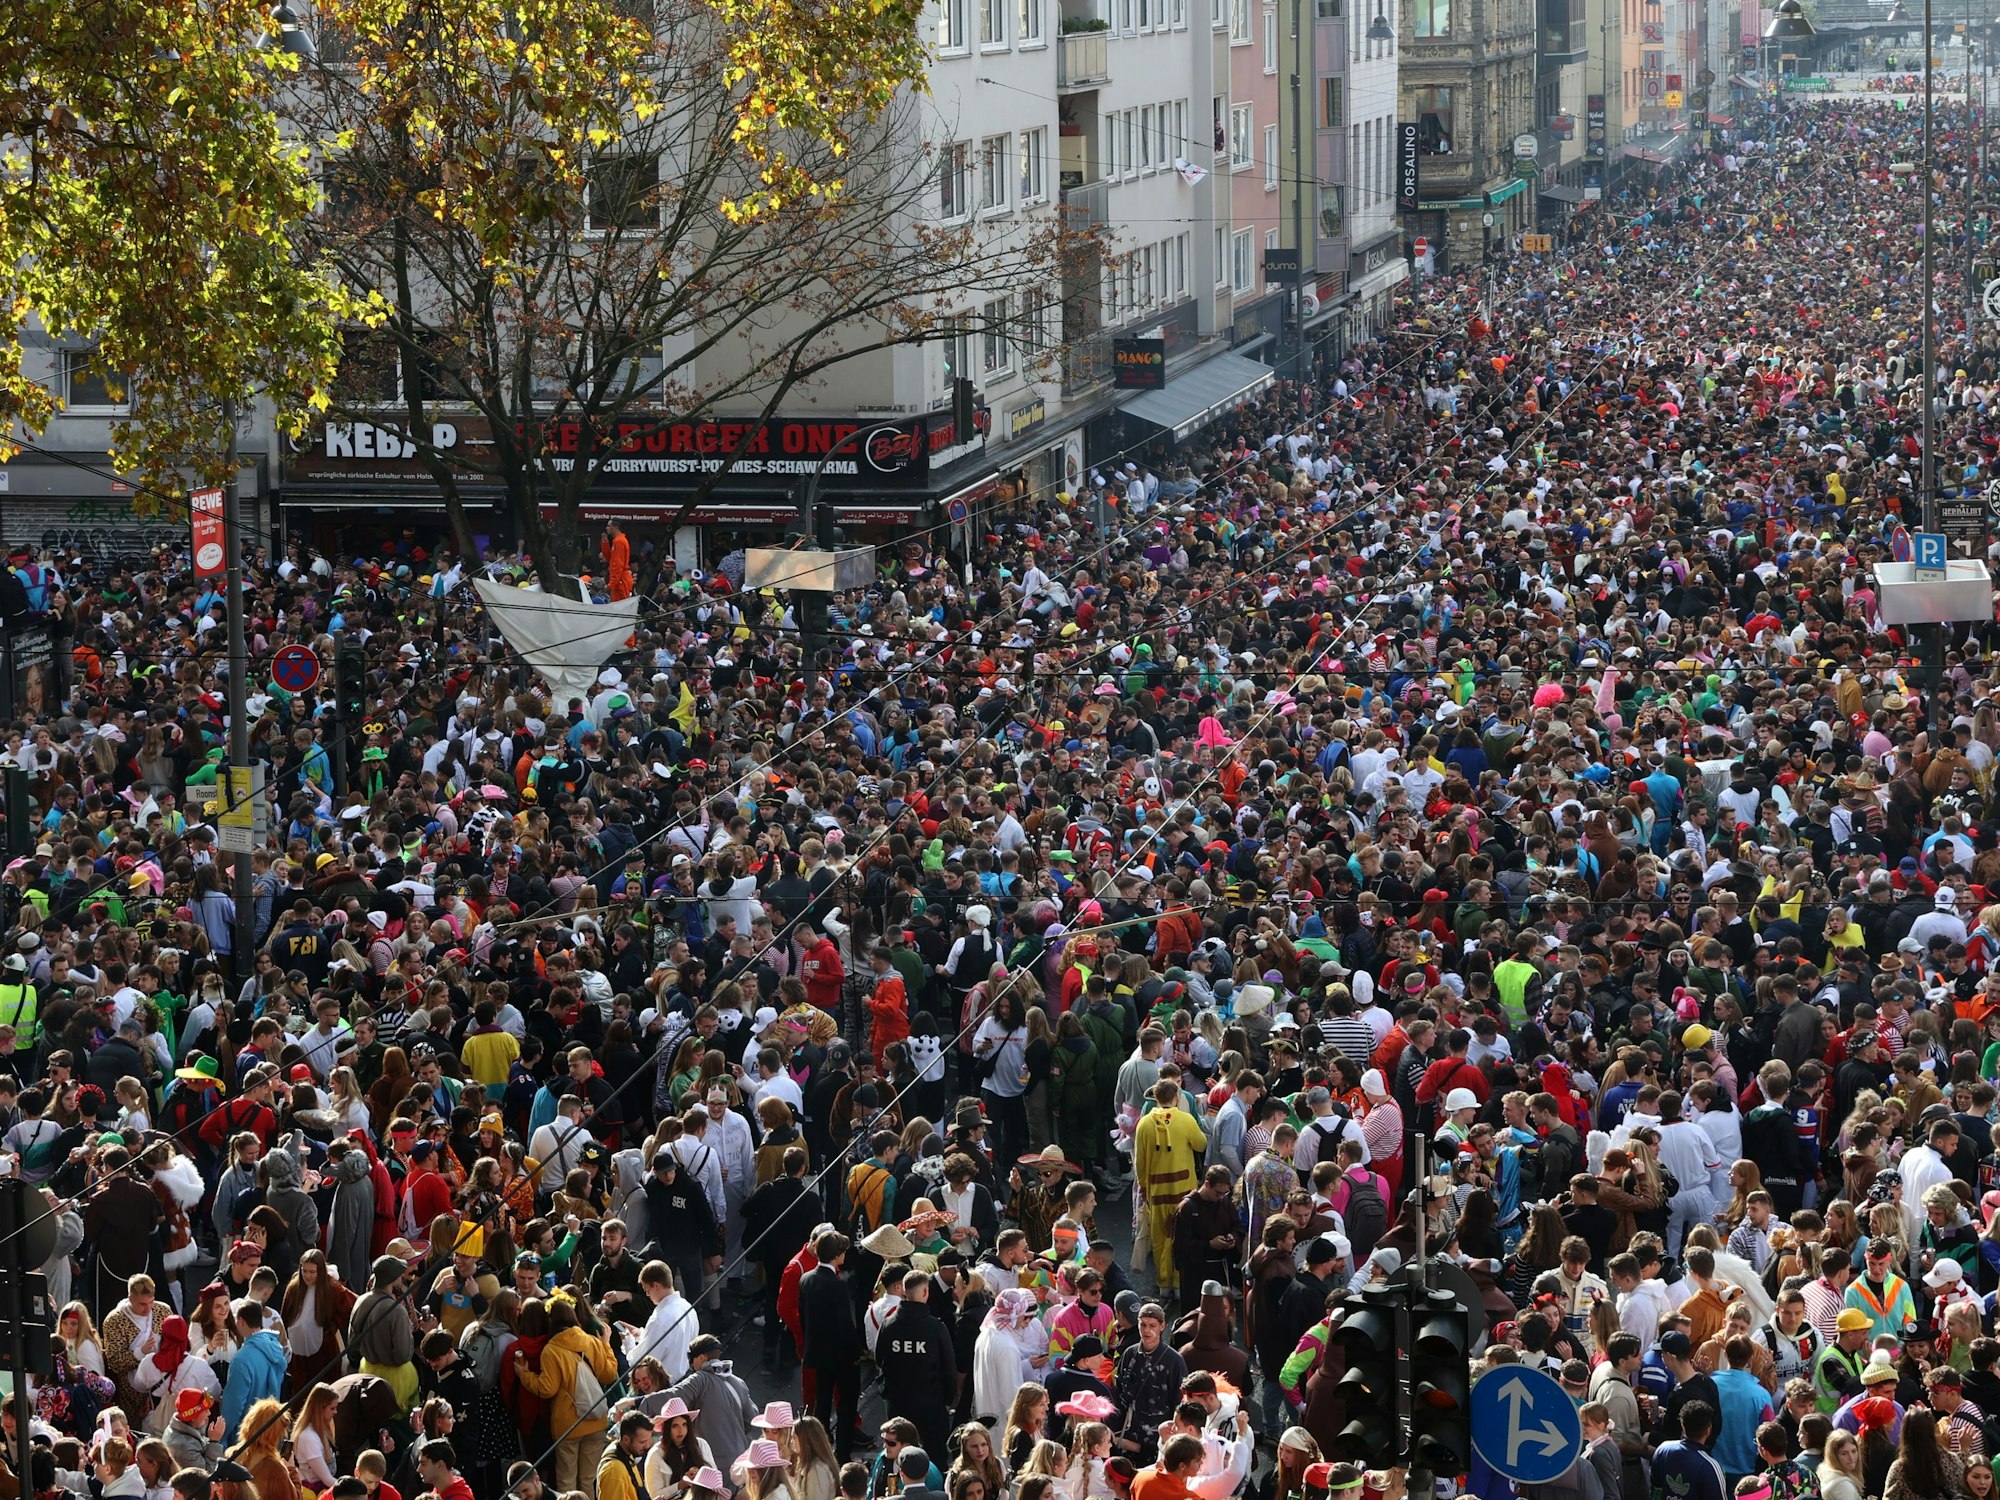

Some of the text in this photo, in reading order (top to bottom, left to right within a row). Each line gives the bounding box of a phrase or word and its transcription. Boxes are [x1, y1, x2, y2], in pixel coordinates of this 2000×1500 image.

[782, 423, 860, 454] ONE
[191, 491, 223, 512] REWE
[1921, 538, 1938, 563] P
[289, 935, 318, 956] FBI
[671, 1195, 687, 1209] SEK
[891, 1340, 927, 1354] SEK
